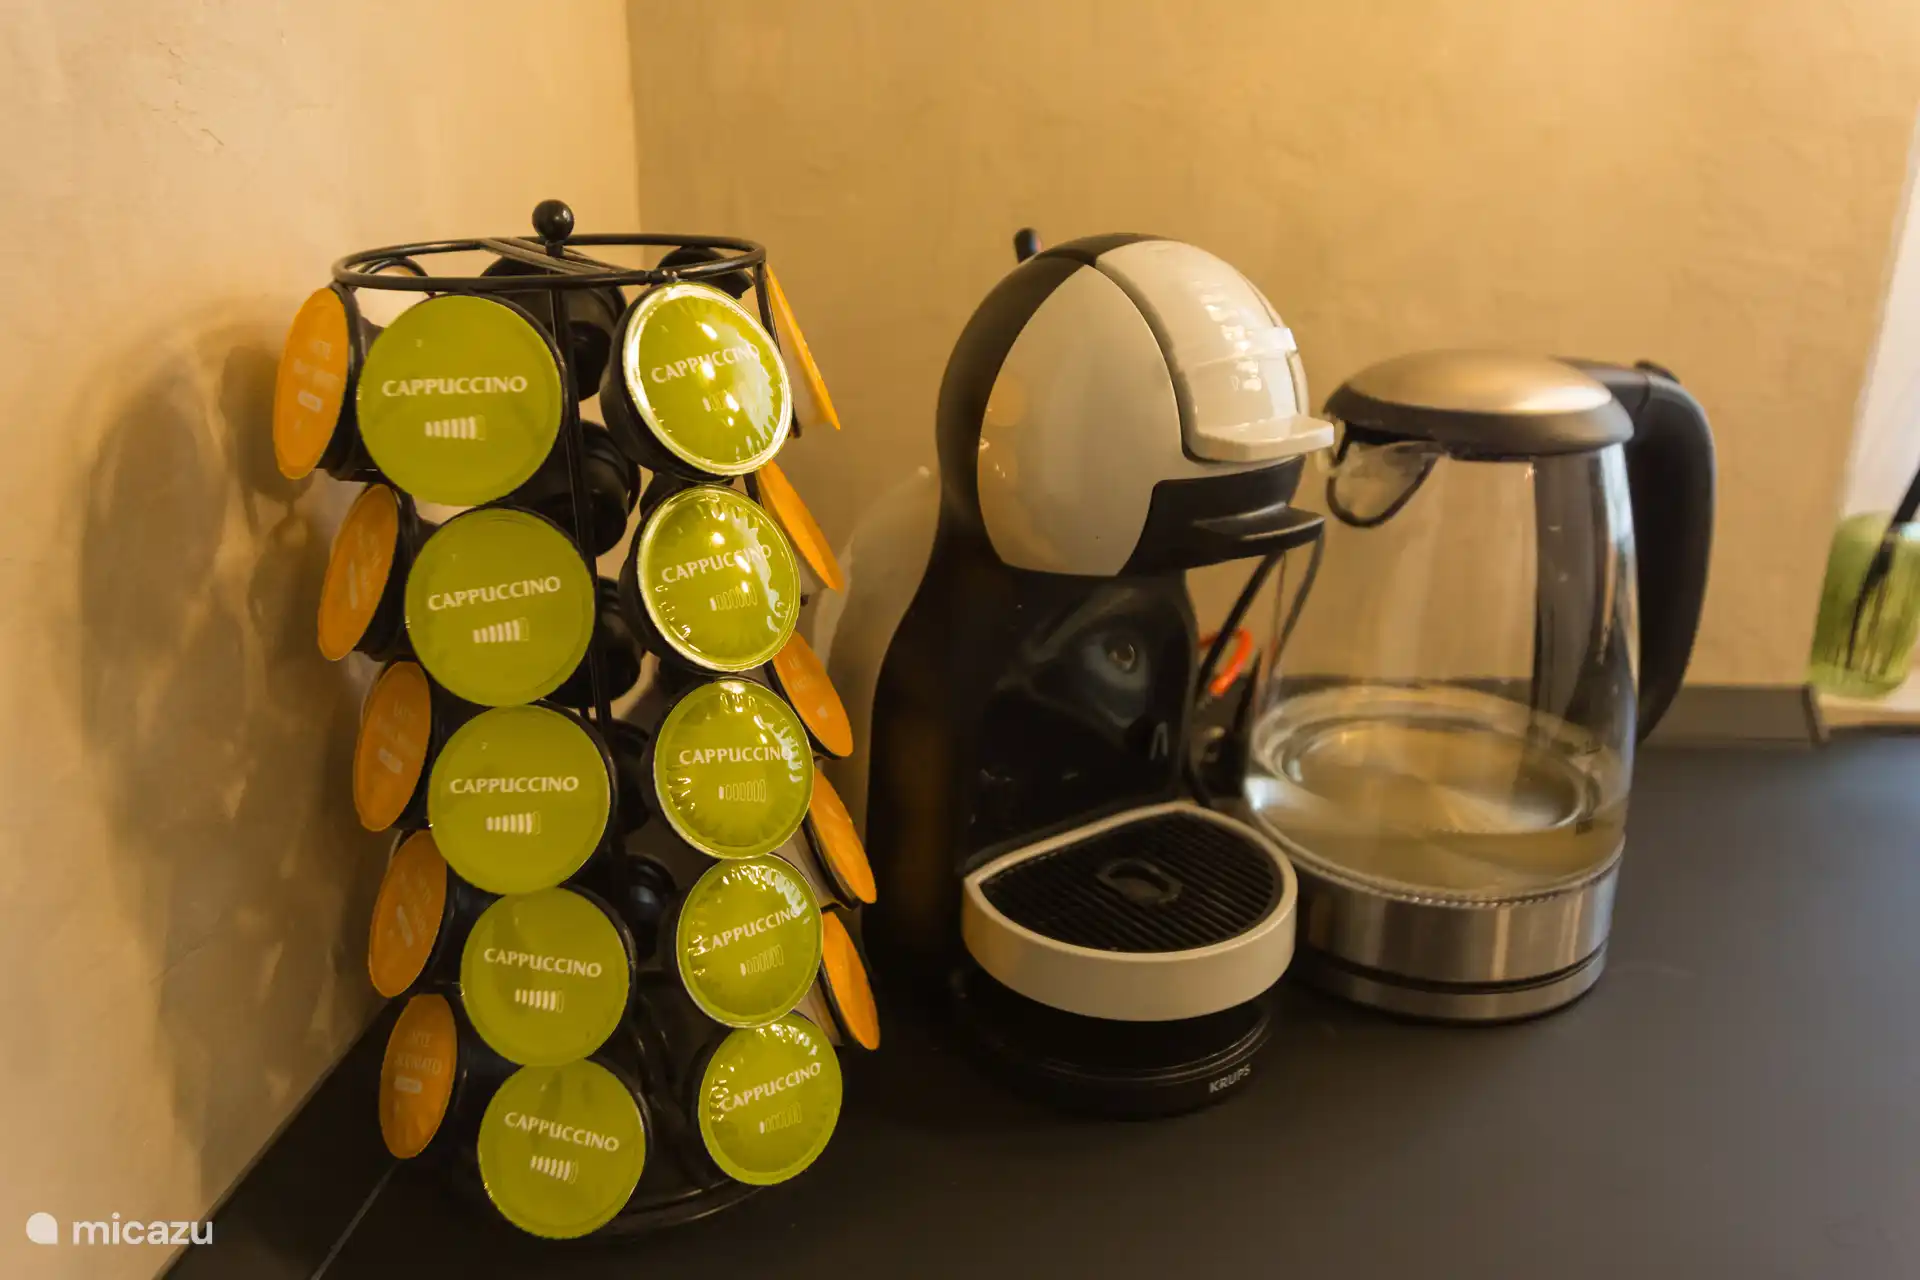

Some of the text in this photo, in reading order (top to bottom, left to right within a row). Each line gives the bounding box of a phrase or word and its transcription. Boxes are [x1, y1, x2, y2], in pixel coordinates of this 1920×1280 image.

[381, 375, 528, 397] CAPPUCCINO
[661, 544, 772, 583] CAPPUCCINO
[428, 576, 561, 611] CAPPUCCINO
[679, 747, 791, 765] CAPPUCCINO
[450, 776, 579, 794] CAPPUCCINO
[699, 907, 798, 953] CAPPUCCINO
[484, 949, 602, 978] CAPPUCCINO
[719, 1062, 821, 1112] CAPPUCCINO
[1209, 1062, 1251, 1093] KRUPS
[504, 1112, 620, 1152] CAPPUCCINO
